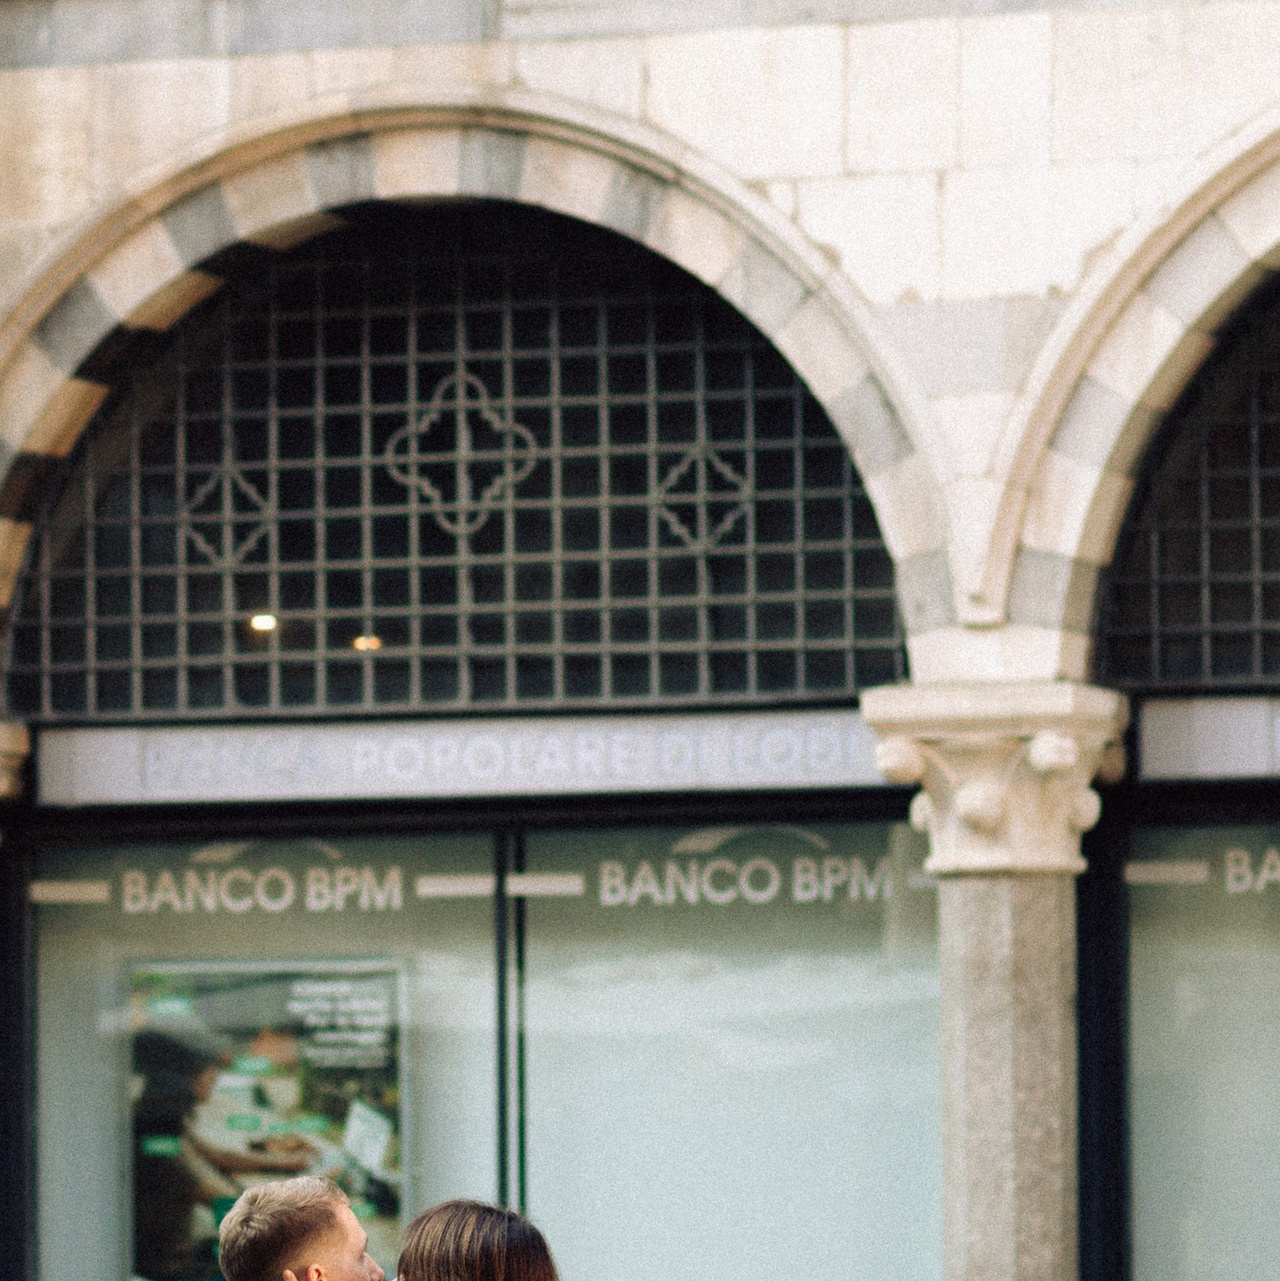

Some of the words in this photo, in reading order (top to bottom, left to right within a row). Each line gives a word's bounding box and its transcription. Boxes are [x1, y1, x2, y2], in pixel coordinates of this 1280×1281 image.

[351, 732, 634, 781] POPOLARE
[656, 730, 708, 774] DI
[122, 867, 295, 914] BANCO
[305, 865, 404, 912] BPM
[599, 856, 781, 907] BANCO
[792, 854, 894, 903] BPM
